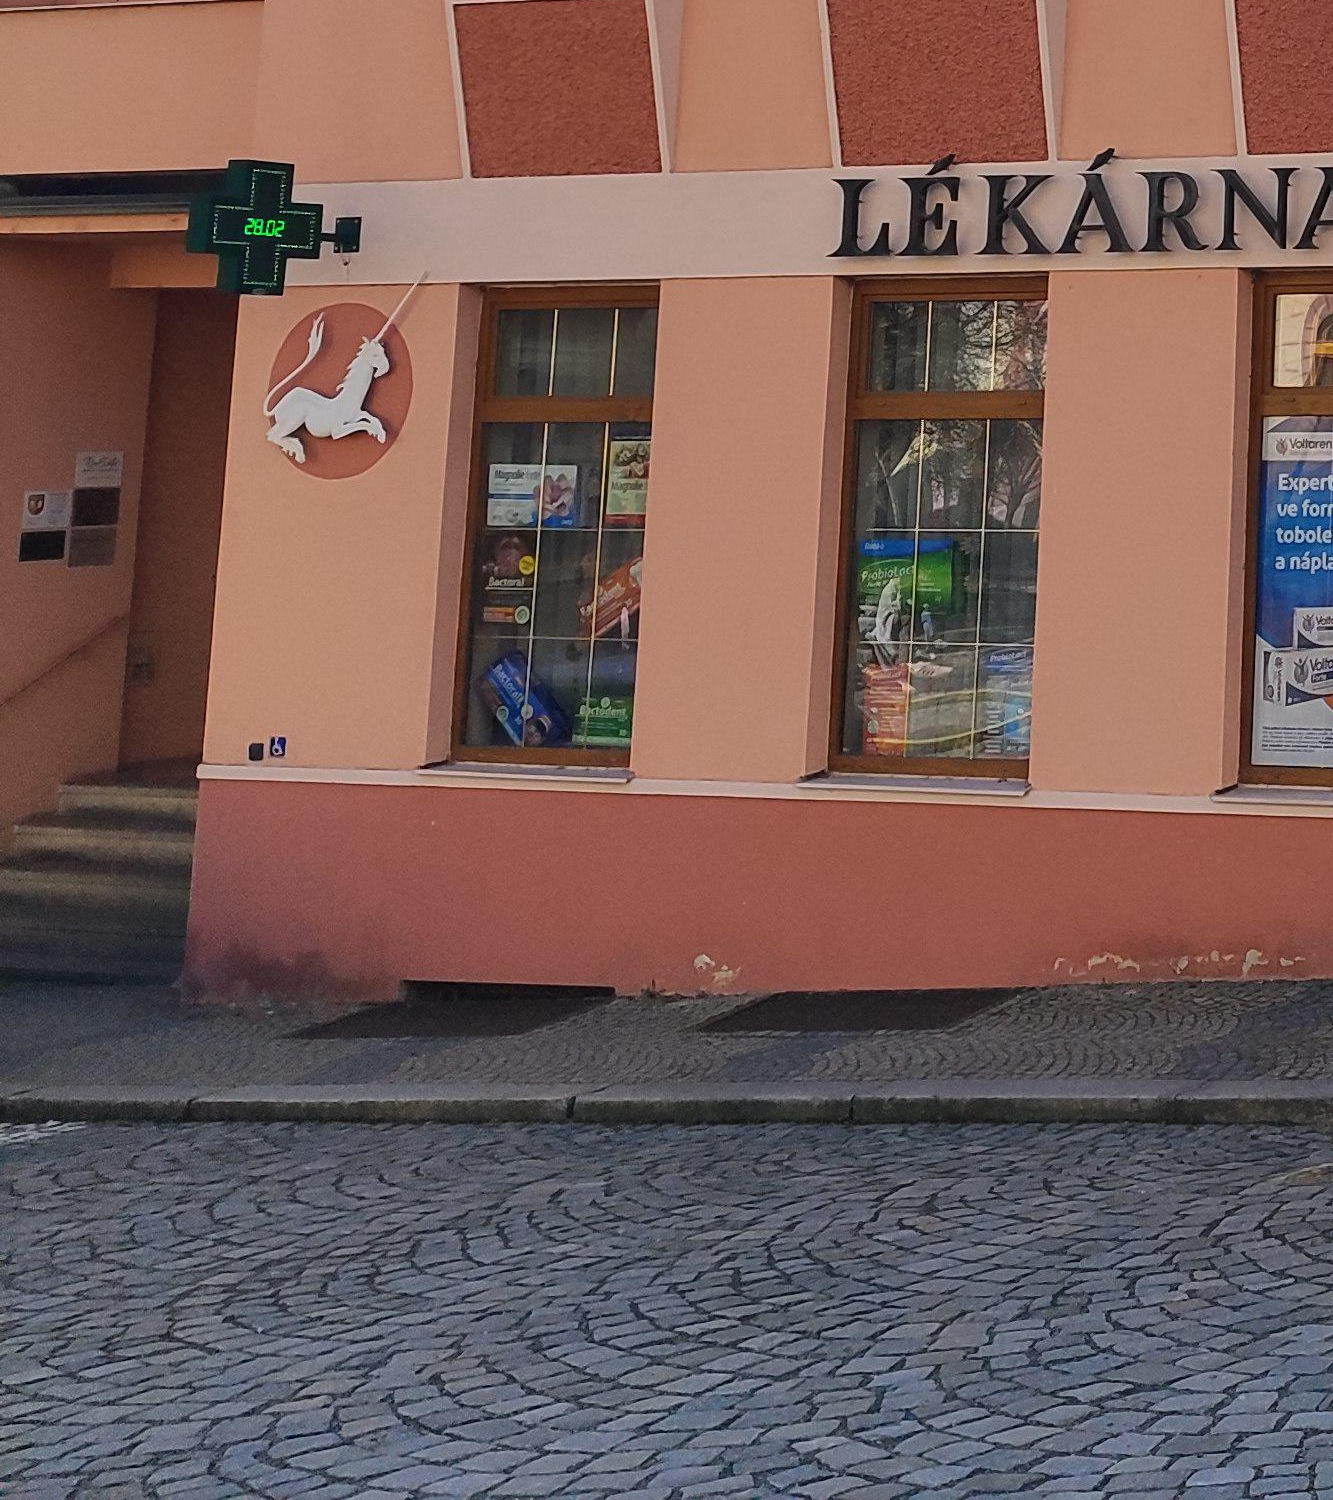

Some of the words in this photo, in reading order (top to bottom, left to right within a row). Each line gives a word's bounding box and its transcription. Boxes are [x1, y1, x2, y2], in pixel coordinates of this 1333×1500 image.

[244, 217, 286, 238] 28.02
[1289, 437, 1333, 451] Voltaren
[1277, 503, 1298, 518] ve
[1275, 557, 1286, 570] a
[860, 563, 915, 581] ProbioLac
